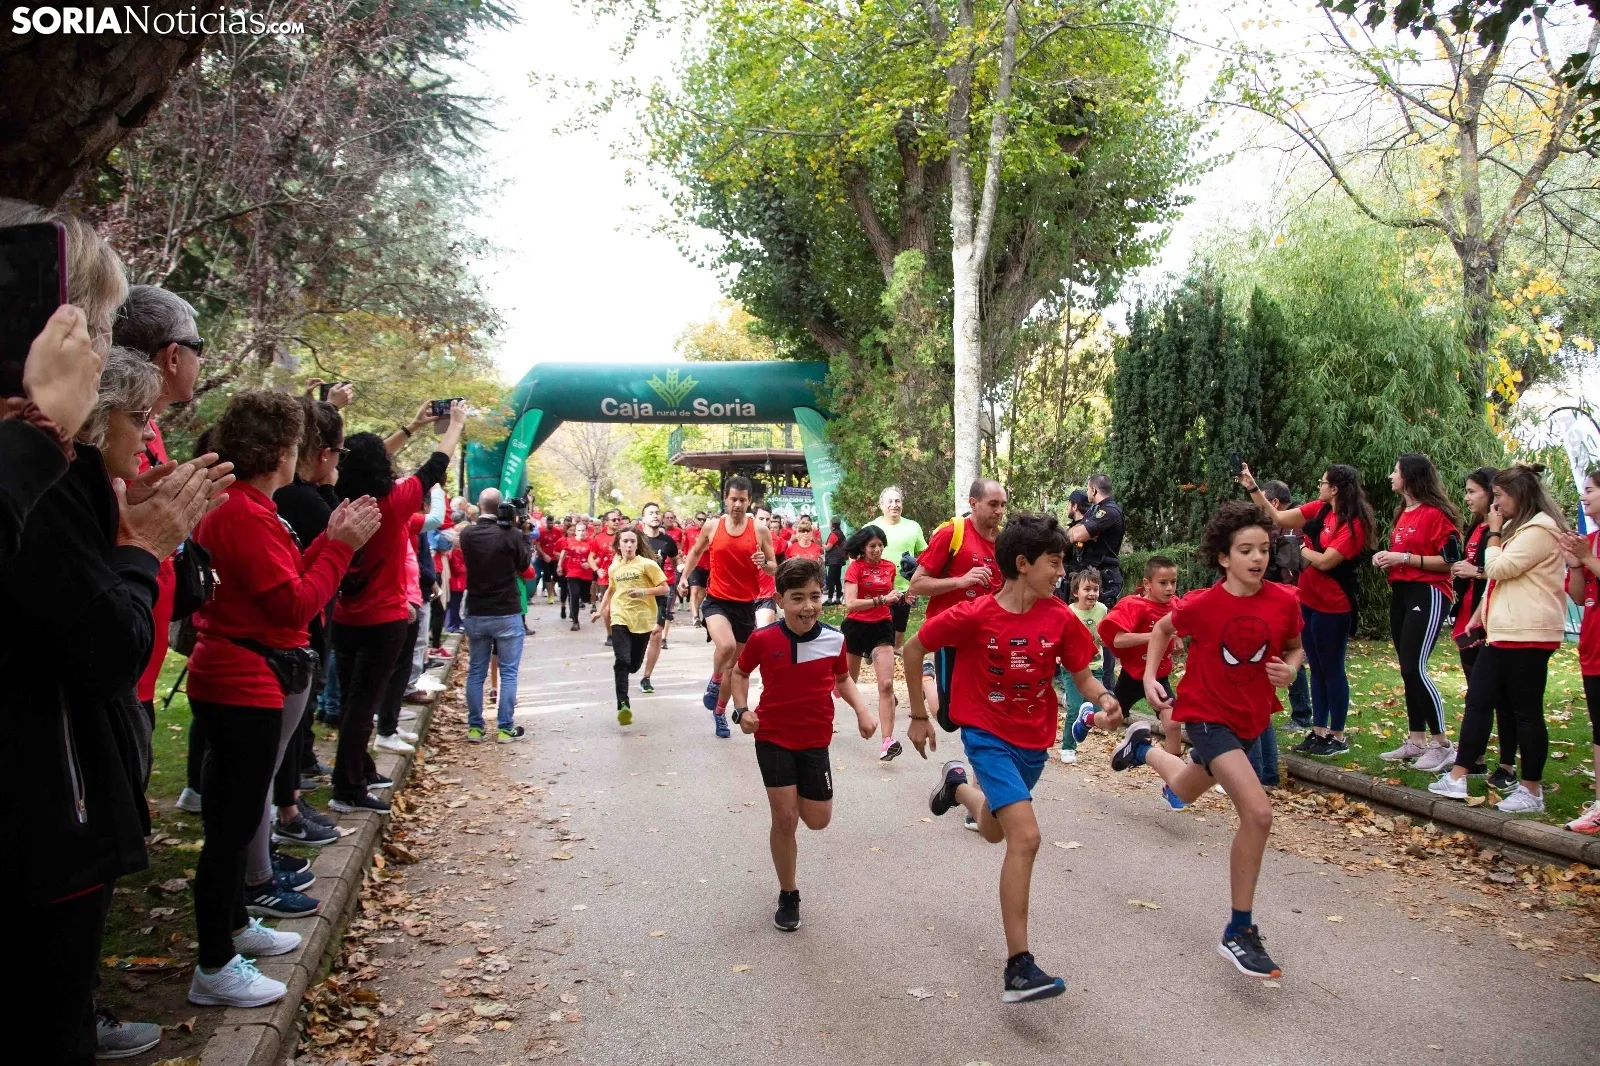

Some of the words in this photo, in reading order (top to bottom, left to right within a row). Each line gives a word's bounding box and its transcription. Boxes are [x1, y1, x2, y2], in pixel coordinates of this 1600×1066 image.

[600, 397, 653, 419] Caja
[656, 409, 677, 417] rural
[679, 409, 691, 417] de
[692, 397, 756, 417] Soria
